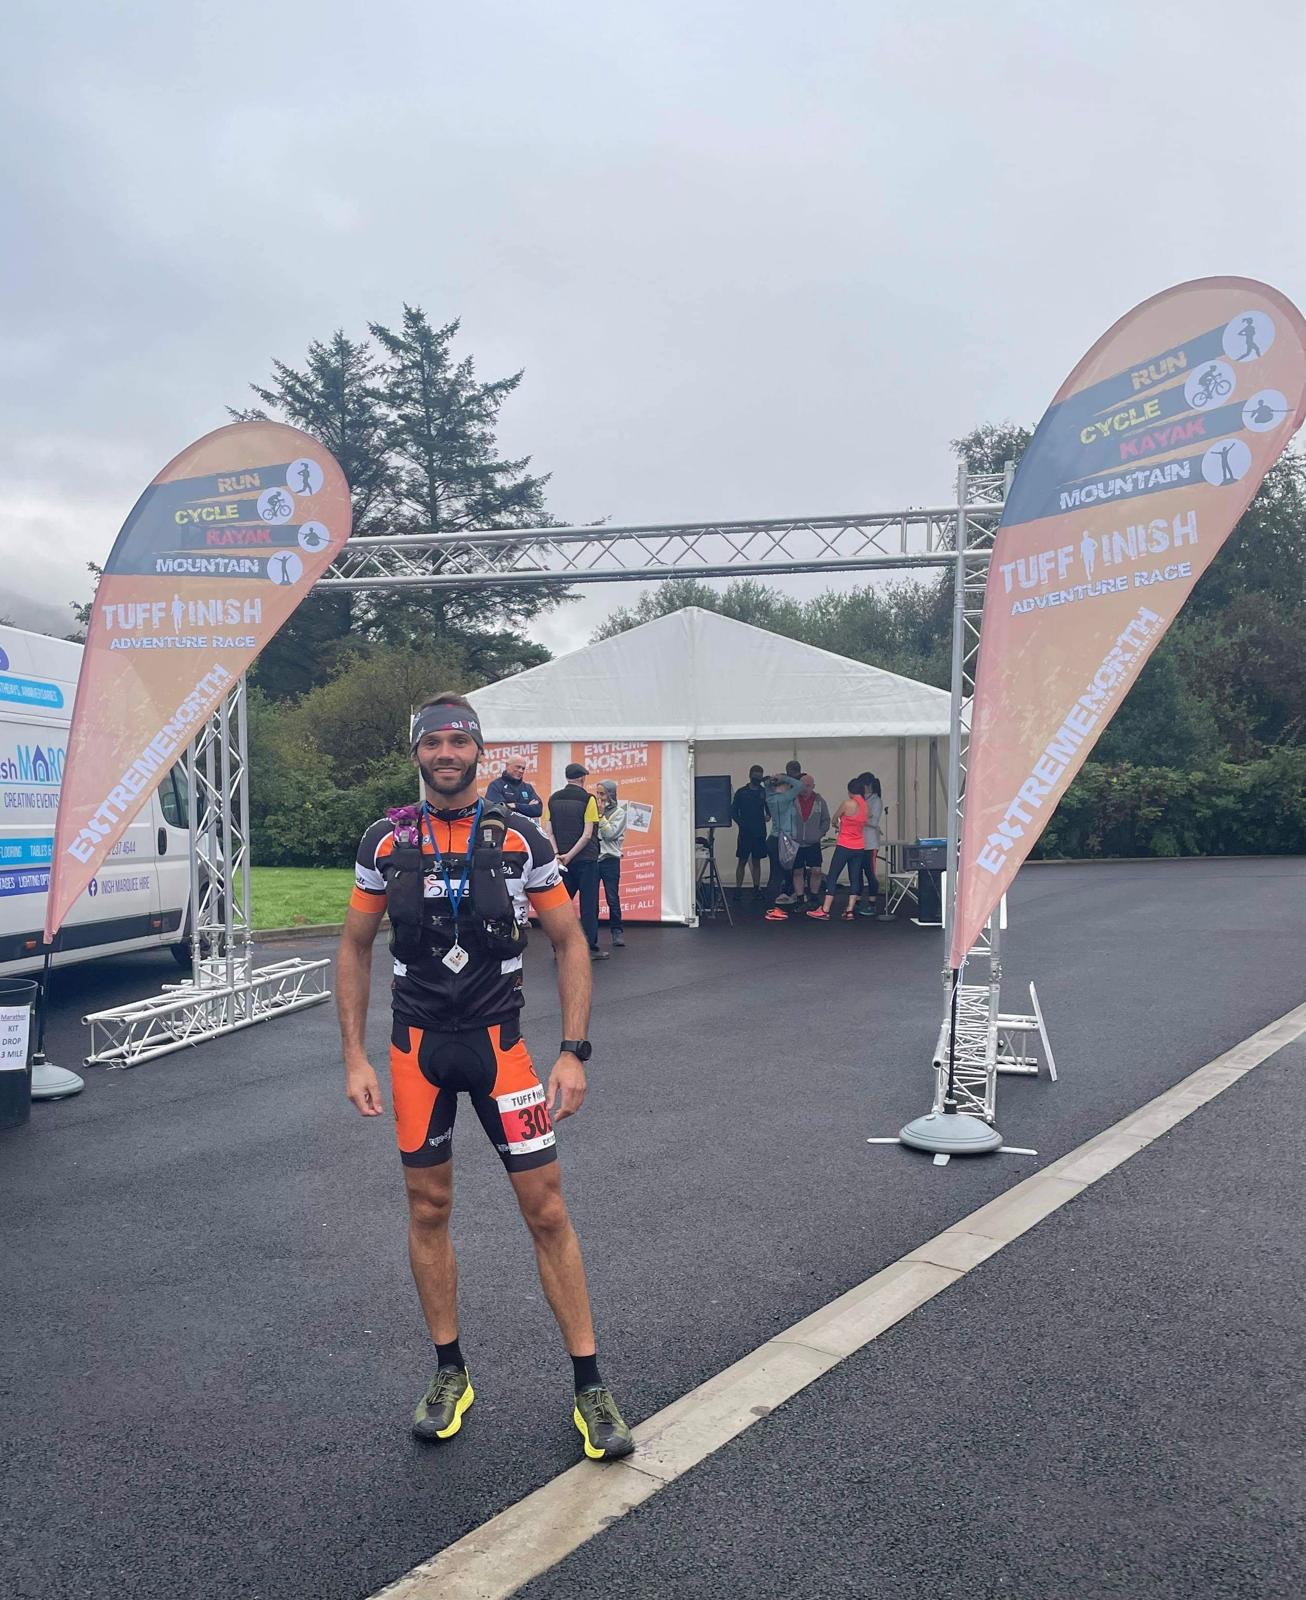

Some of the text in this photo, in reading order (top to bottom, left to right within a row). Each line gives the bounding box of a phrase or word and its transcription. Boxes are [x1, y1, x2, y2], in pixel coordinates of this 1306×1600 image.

[1130, 350, 1189, 390] RUN
[1080, 398, 1162, 446] CYCLE
[1119, 417, 1206, 461] KAYAK
[217, 472, 261, 493] RUN
[1059, 460, 1191, 510] MOUNTAIN
[174, 504, 240, 525] CYCLE
[205, 528, 273, 546] KAYAK
[155, 556, 260, 574] MOUNTAIN
[1000, 544, 1074, 594] TUFF
[1009, 560, 1193, 616] ADVENTURE RACE
[101, 601, 166, 631] TUFF
[109, 635, 257, 651] ADVENTURE RACE
[483, 743, 539, 760] XTREME
[584, 741, 649, 757] EXTREME
[477, 754, 538, 777] NOH
[584, 748, 648, 773] NORTH
[4, 791, 60, 809] CREATING EVENTS
[30, 844, 48, 857] TABLES
[633, 860, 656, 869] Scenery
[115, 877, 139, 893] MARQUEE
[139, 876, 150, 890] HIRE
[625, 884, 656, 894] Hospitality
[637, 899, 655, 910] ALL!
[7, 1050, 23, 1058] MILE
[511, 1093, 533, 1107] TUFF
